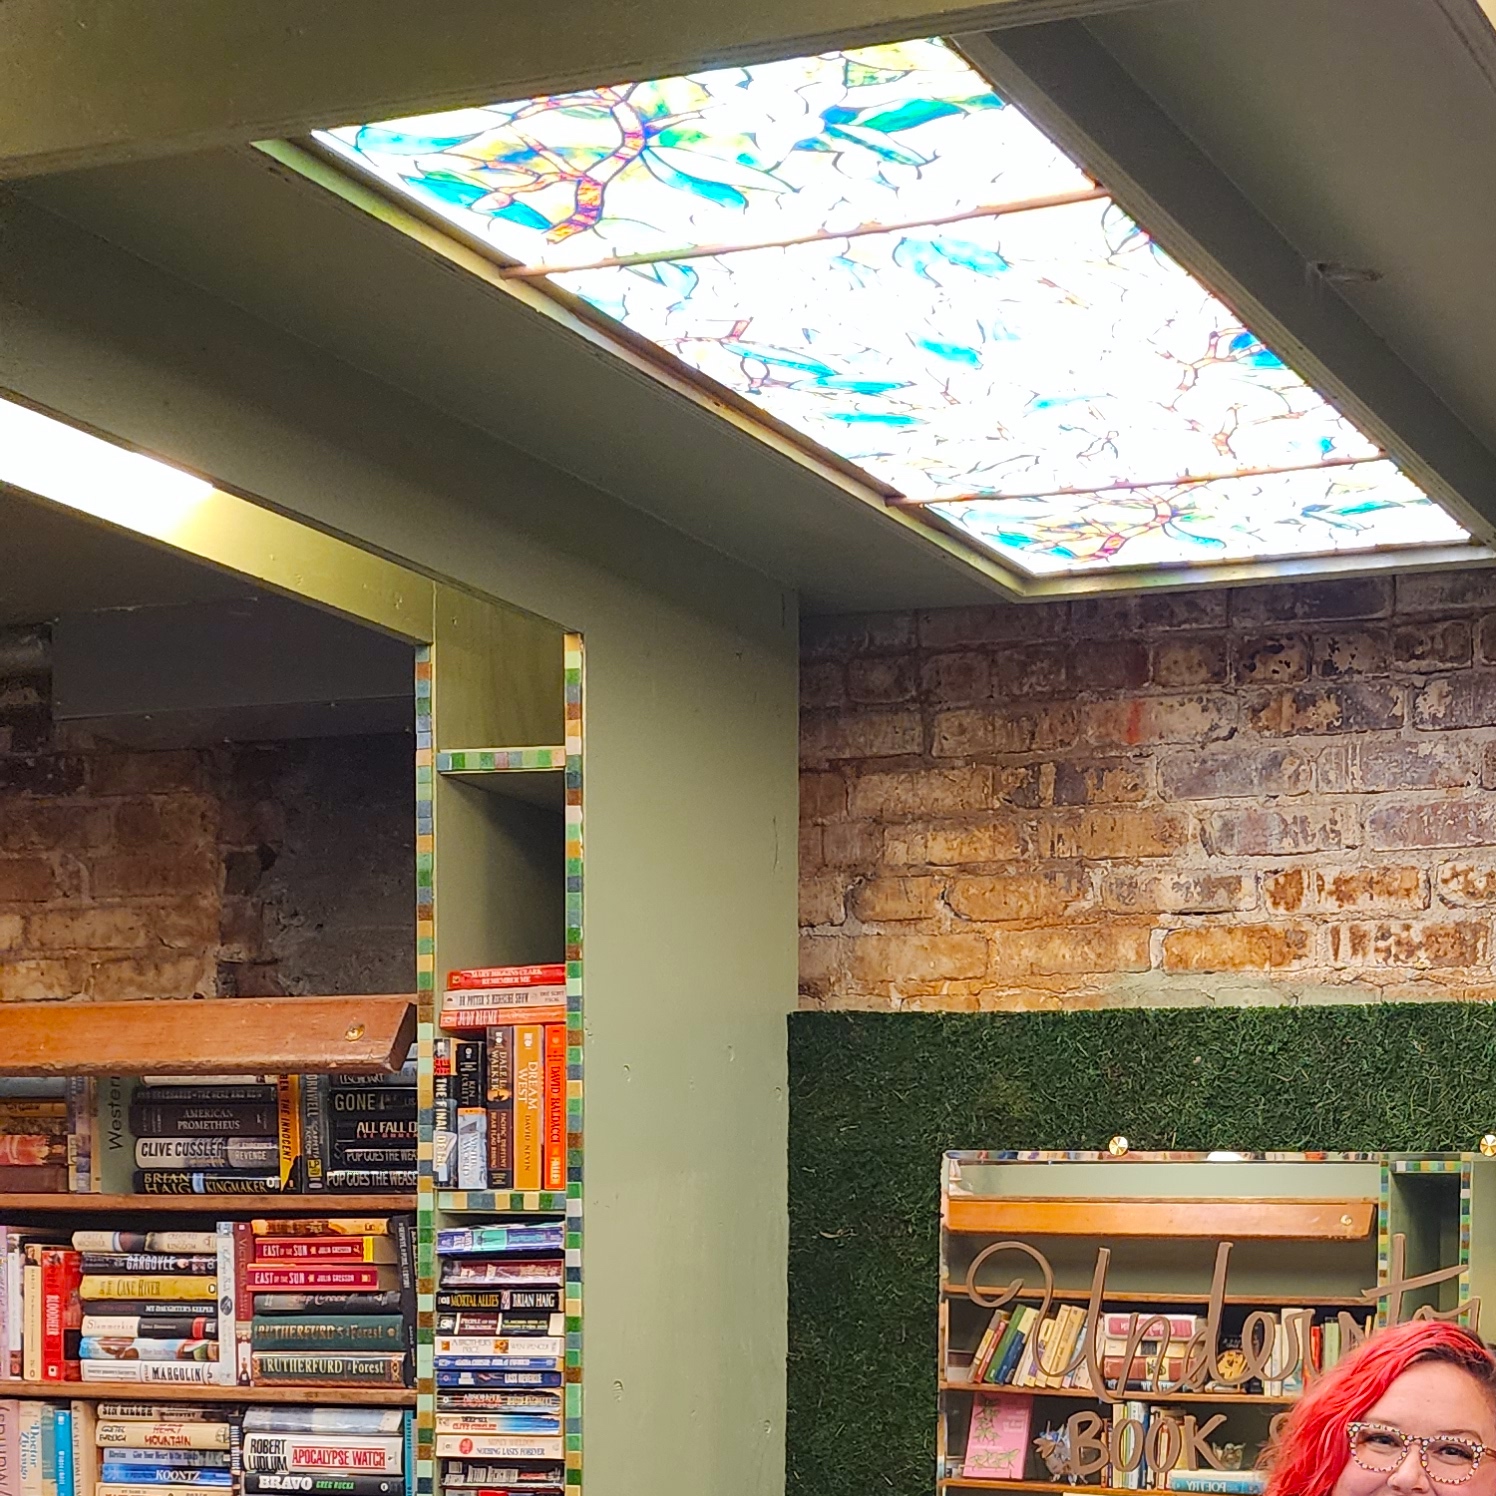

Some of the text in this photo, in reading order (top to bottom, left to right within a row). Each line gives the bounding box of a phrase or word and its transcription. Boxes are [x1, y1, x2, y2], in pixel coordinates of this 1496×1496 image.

[334, 1093, 375, 1111] GONE
[183, 1108, 234, 1119] AMERICAN
[177, 1119, 241, 1131] PROMETHEUS
[357, 1121, 406, 1133] ALL FALL
[141, 1141, 224, 1157] CLIVE CUSSLER
[235, 1151, 267, 1161] REVENGE
[144, 1173, 190, 1183] BRIAN
[144, 1184, 191, 1194] HAIG
[205, 1180, 266, 1193] KINGMAKER
[262, 1245, 308, 1257] EAST SUN
[126, 1257, 176, 1271] GARGOYLE
[268, 1358, 384, 1374] RUTHERFURD Forest
[152, 1367, 201, 1382] MARGOLIN
[250, 1438, 287, 1455] ROBERT
[1066, 1410, 1228, 1475] BOOK
[248, 1454, 289, 1471] LUDLUM
[292, 1449, 386, 1467] APOCALYPSE WATCH
[155, 1470, 201, 1482] KOONTZ
[259, 1476, 313, 1491] BRAVO
